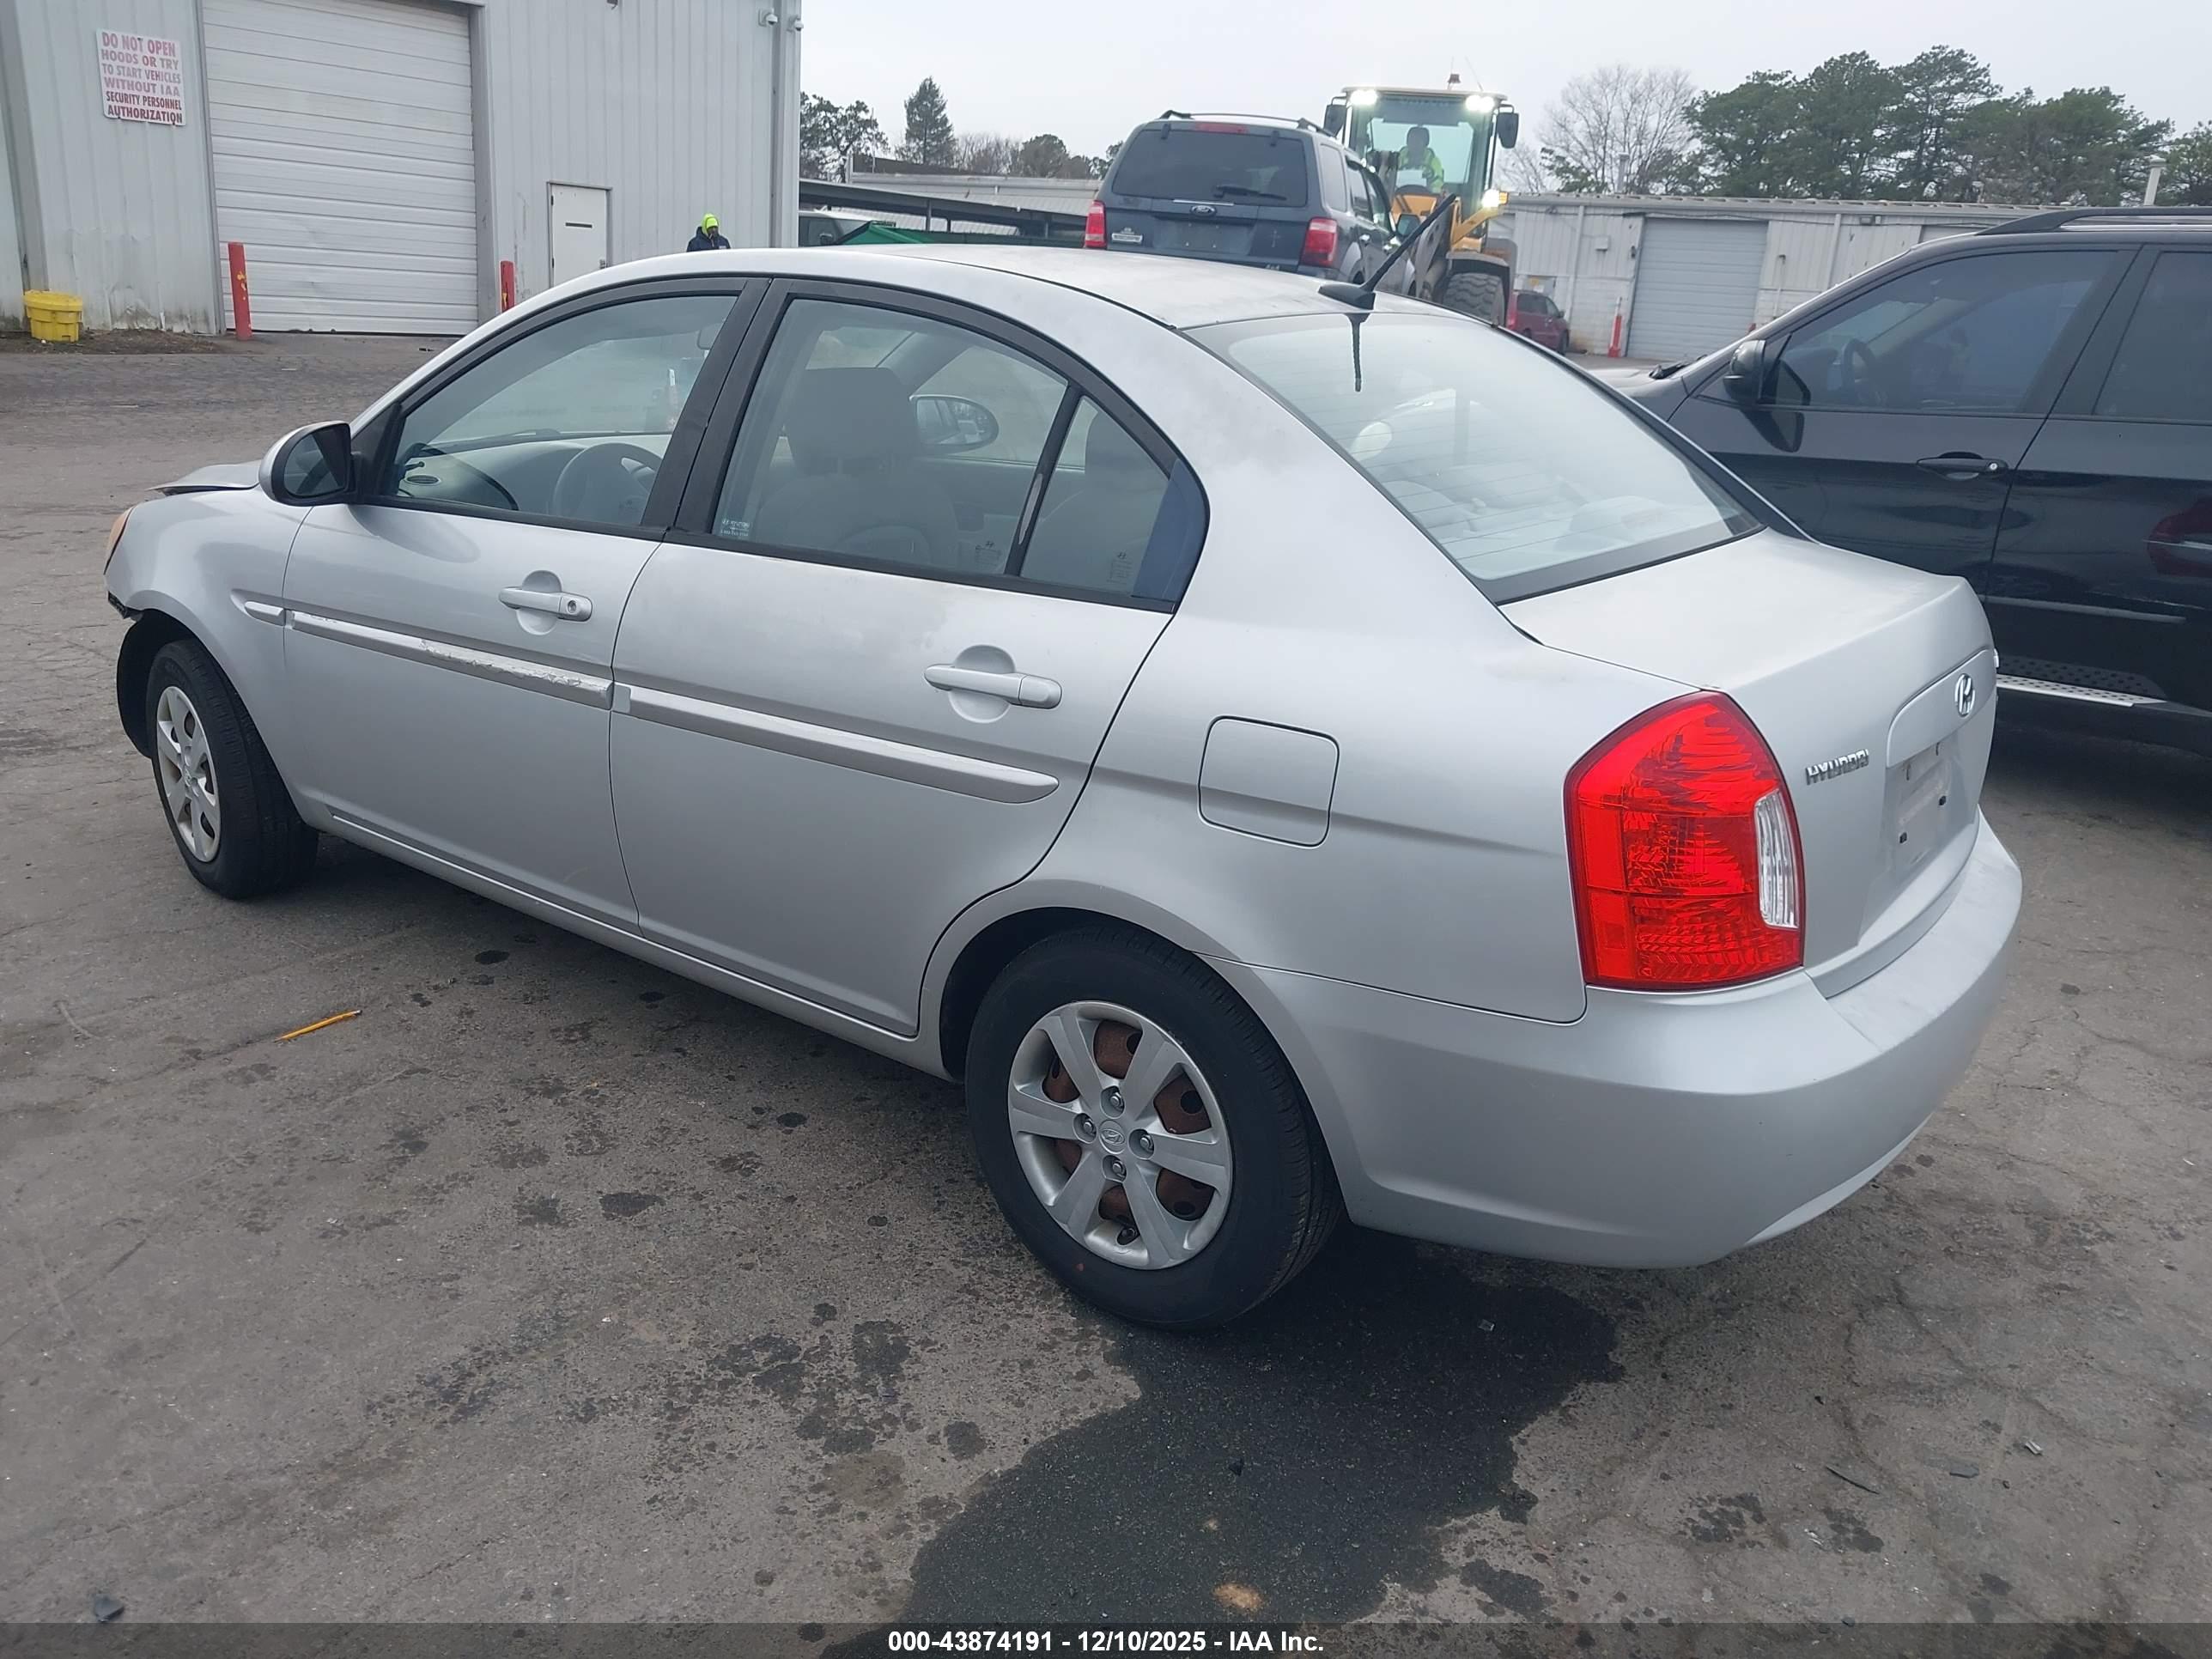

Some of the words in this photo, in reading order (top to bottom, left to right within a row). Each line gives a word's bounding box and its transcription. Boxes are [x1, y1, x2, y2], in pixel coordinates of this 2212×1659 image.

[102, 33, 118, 49] DO
[122, 35, 144, 52] NOT
[147, 40, 176, 57] OPEN
[101, 49, 138, 64] HOODS
[142, 56, 157, 67] OR
[159, 58, 179, 70] TRY
[102, 64, 114, 75] TO
[116, 65, 143, 79] START
[144, 70, 181, 84] VEHICLES
[104, 76, 157, 94] WITHOUT
[161, 84, 180, 97] IAA
[106, 91, 140, 106] SECURITY
[143, 95, 182, 111] PERSONNEL
[107, 105, 183, 124] AUTHORIZATION
